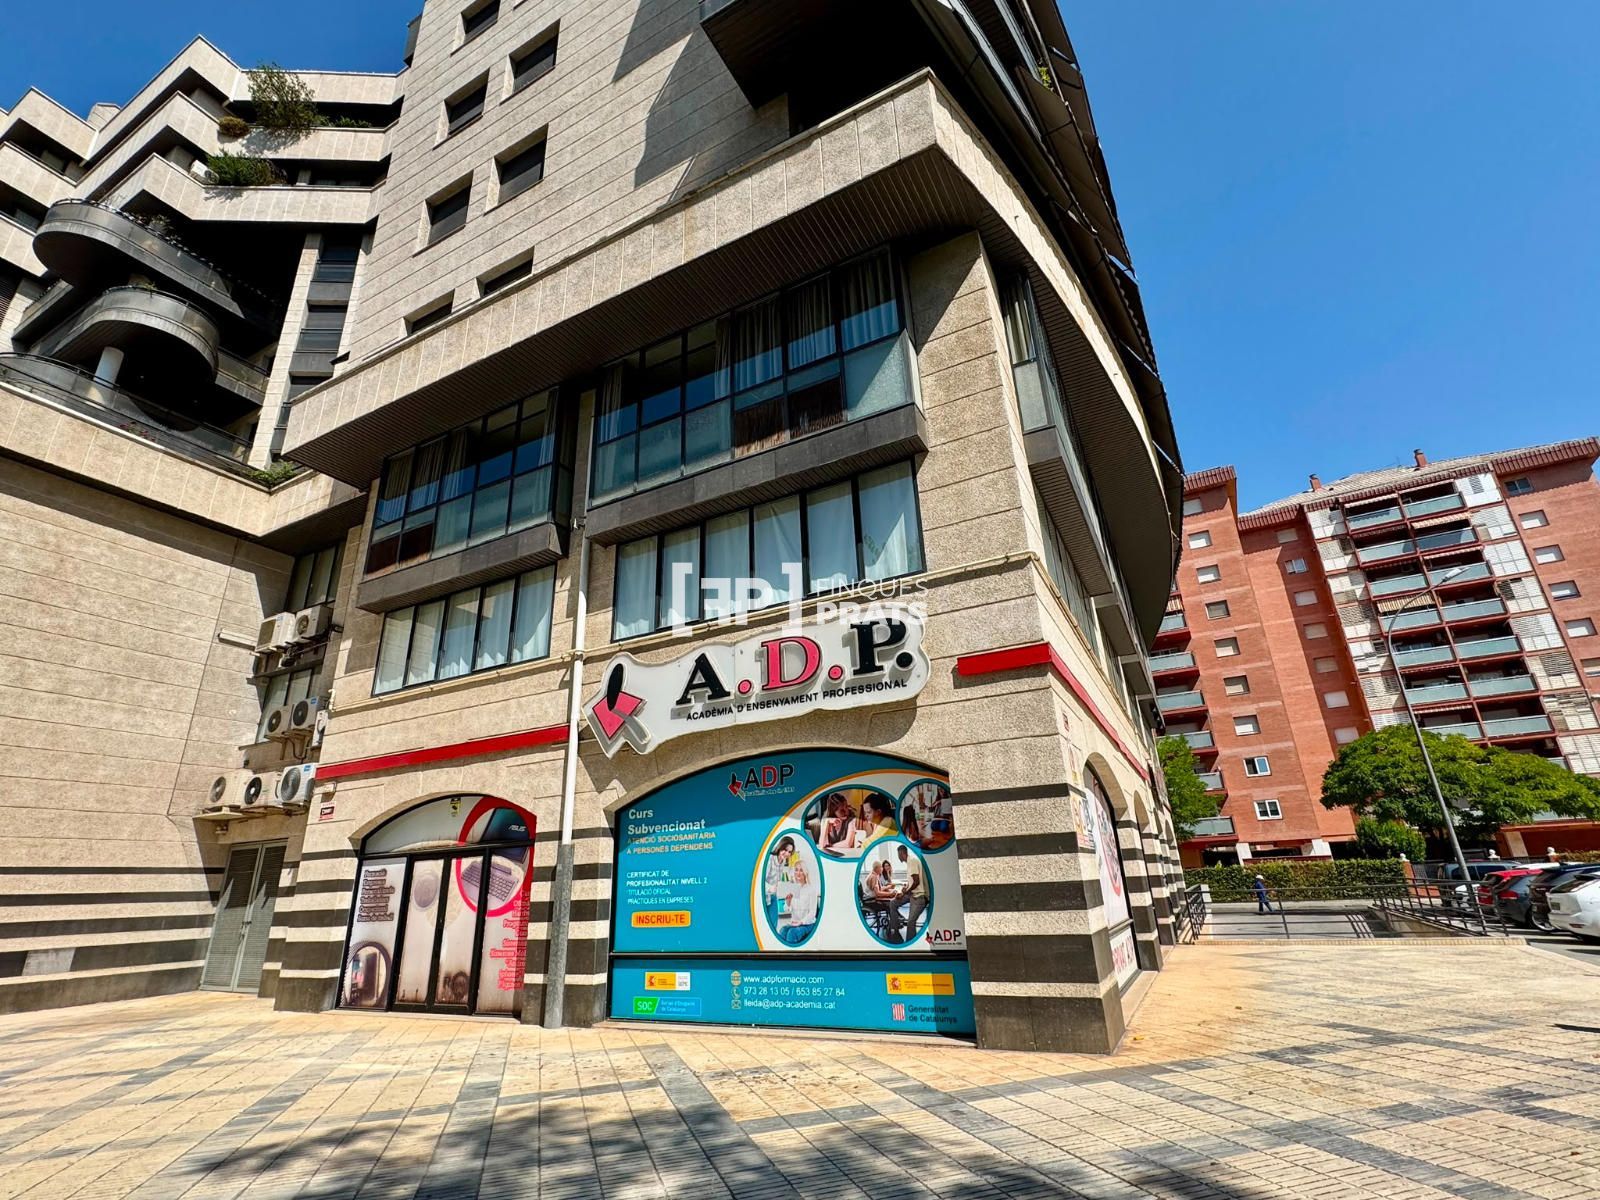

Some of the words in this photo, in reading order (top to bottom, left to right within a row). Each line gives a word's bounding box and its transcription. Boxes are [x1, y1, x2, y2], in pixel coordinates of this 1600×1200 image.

[686, 706, 734, 721] ACADÈMIA
[736, 692, 818, 713] D'ENSENYAMENT
[822, 678, 908, 700] PROFESSIONAL
[744, 763, 794, 789] ADP
[628, 809, 653, 819] Curs
[627, 819, 705, 834] Subvencionat
[633, 845, 669, 855] PERSONES
[626, 870, 660, 879] CERTIFICAT
[660, 869, 670, 877] DE
[680, 877, 702, 885] NIVELL
[636, 913, 685, 924] INSCRIU-TE
[933, 929, 962, 942] ADP
[743, 987, 757, 996] 973
[758, 987, 768, 996] 28
[770, 987, 779, 996] 13
[780, 987, 790, 996] 05
[796, 987, 811, 997] 653
[812, 987, 821, 997] 85
[823, 987, 834, 997] 27
[835, 988, 846, 997] 84
